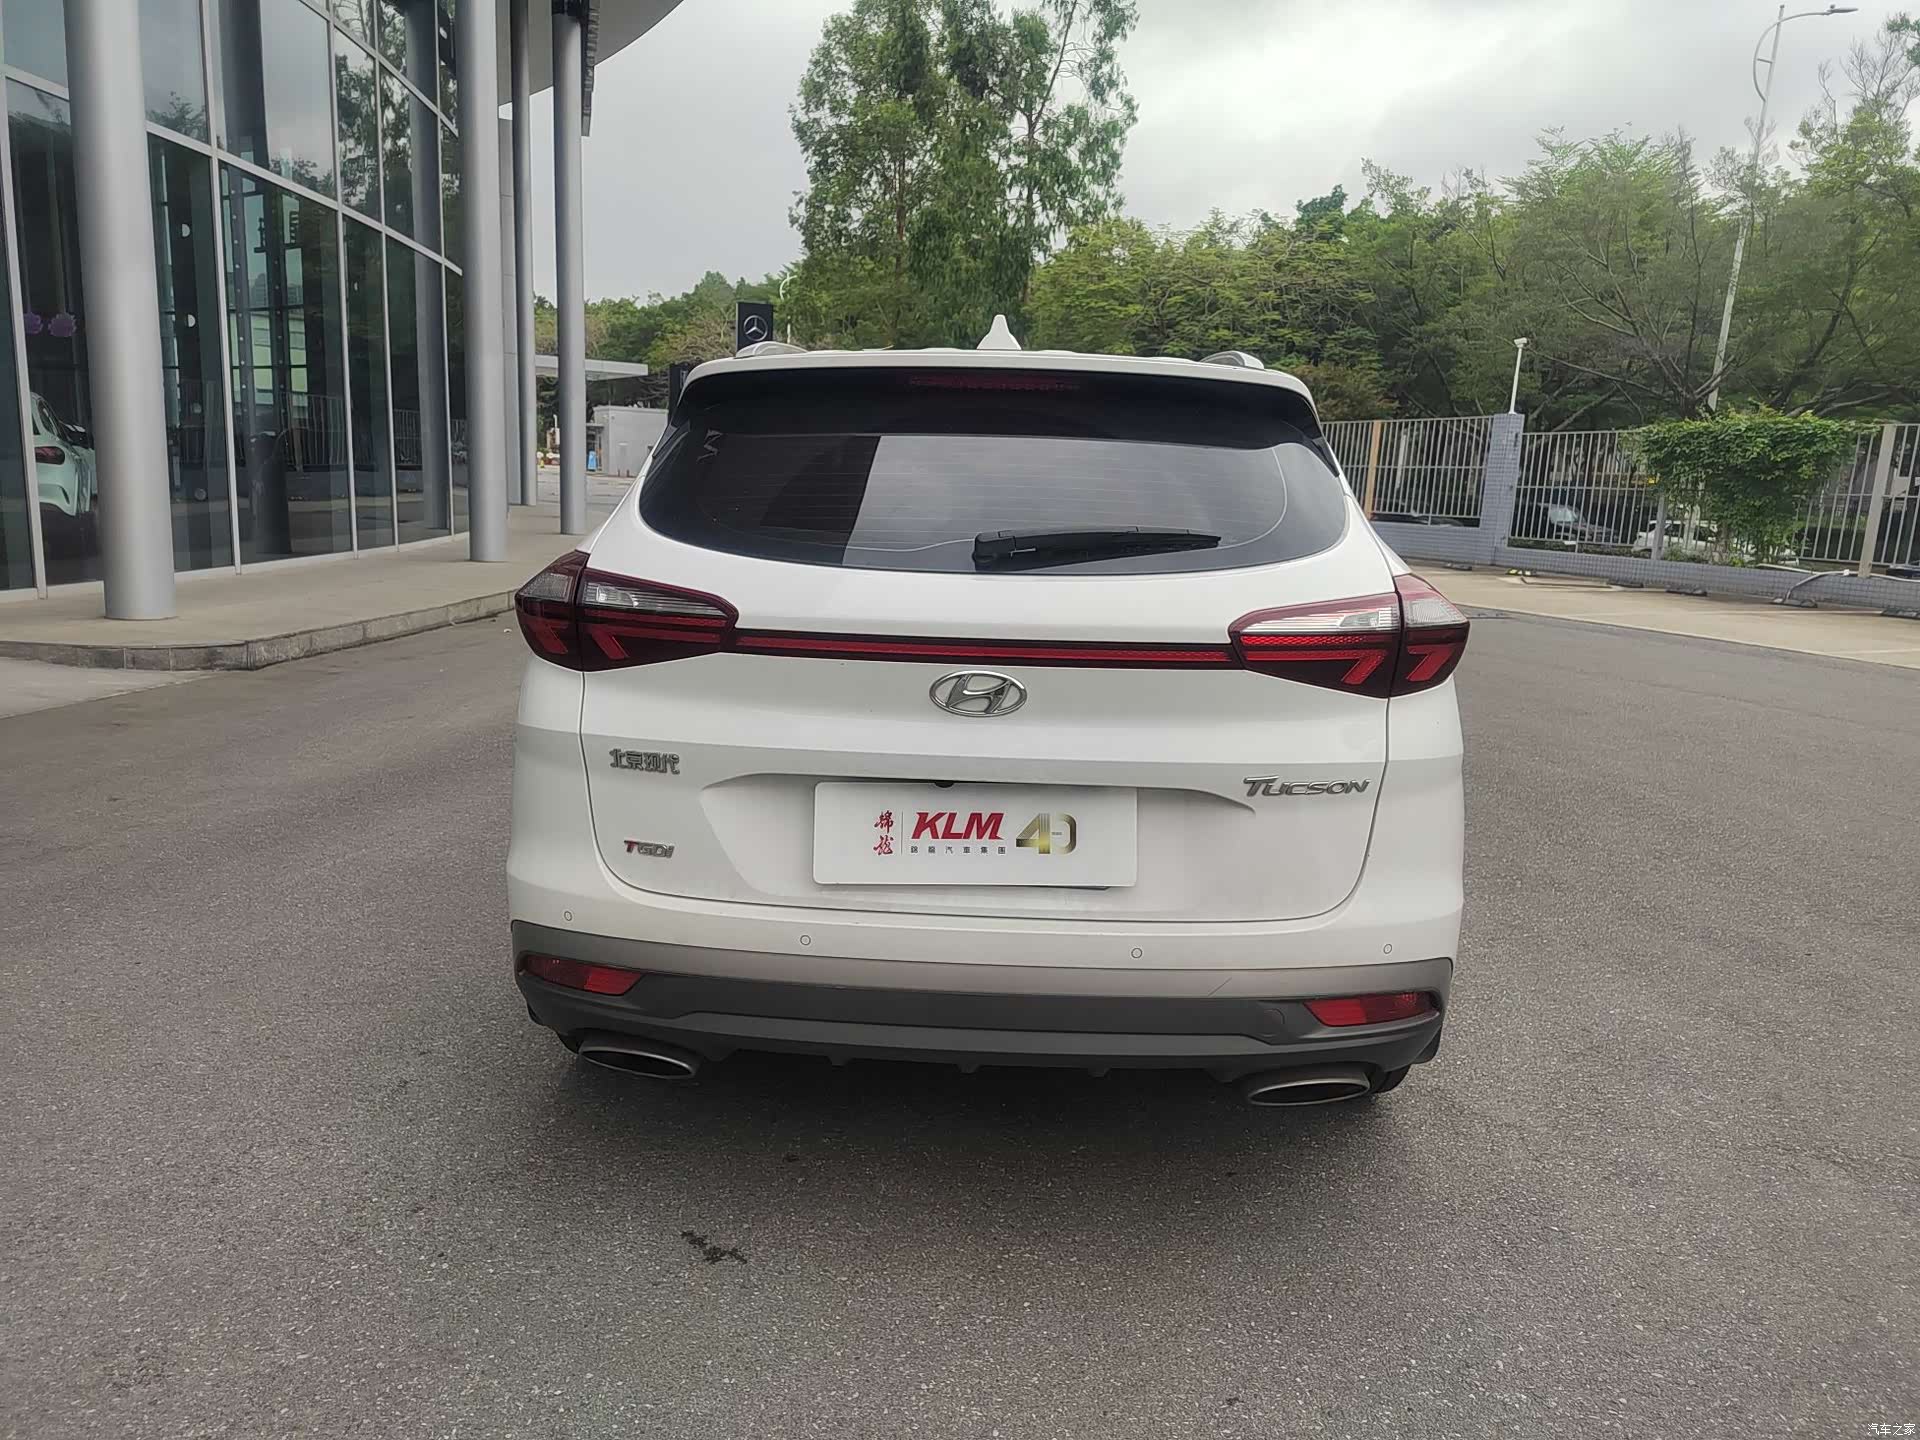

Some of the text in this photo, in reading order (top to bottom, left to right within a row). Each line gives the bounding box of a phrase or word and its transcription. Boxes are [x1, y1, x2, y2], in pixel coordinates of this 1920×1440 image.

[608, 749, 681, 775] 北京现代
[911, 812, 1004, 840] KLM
